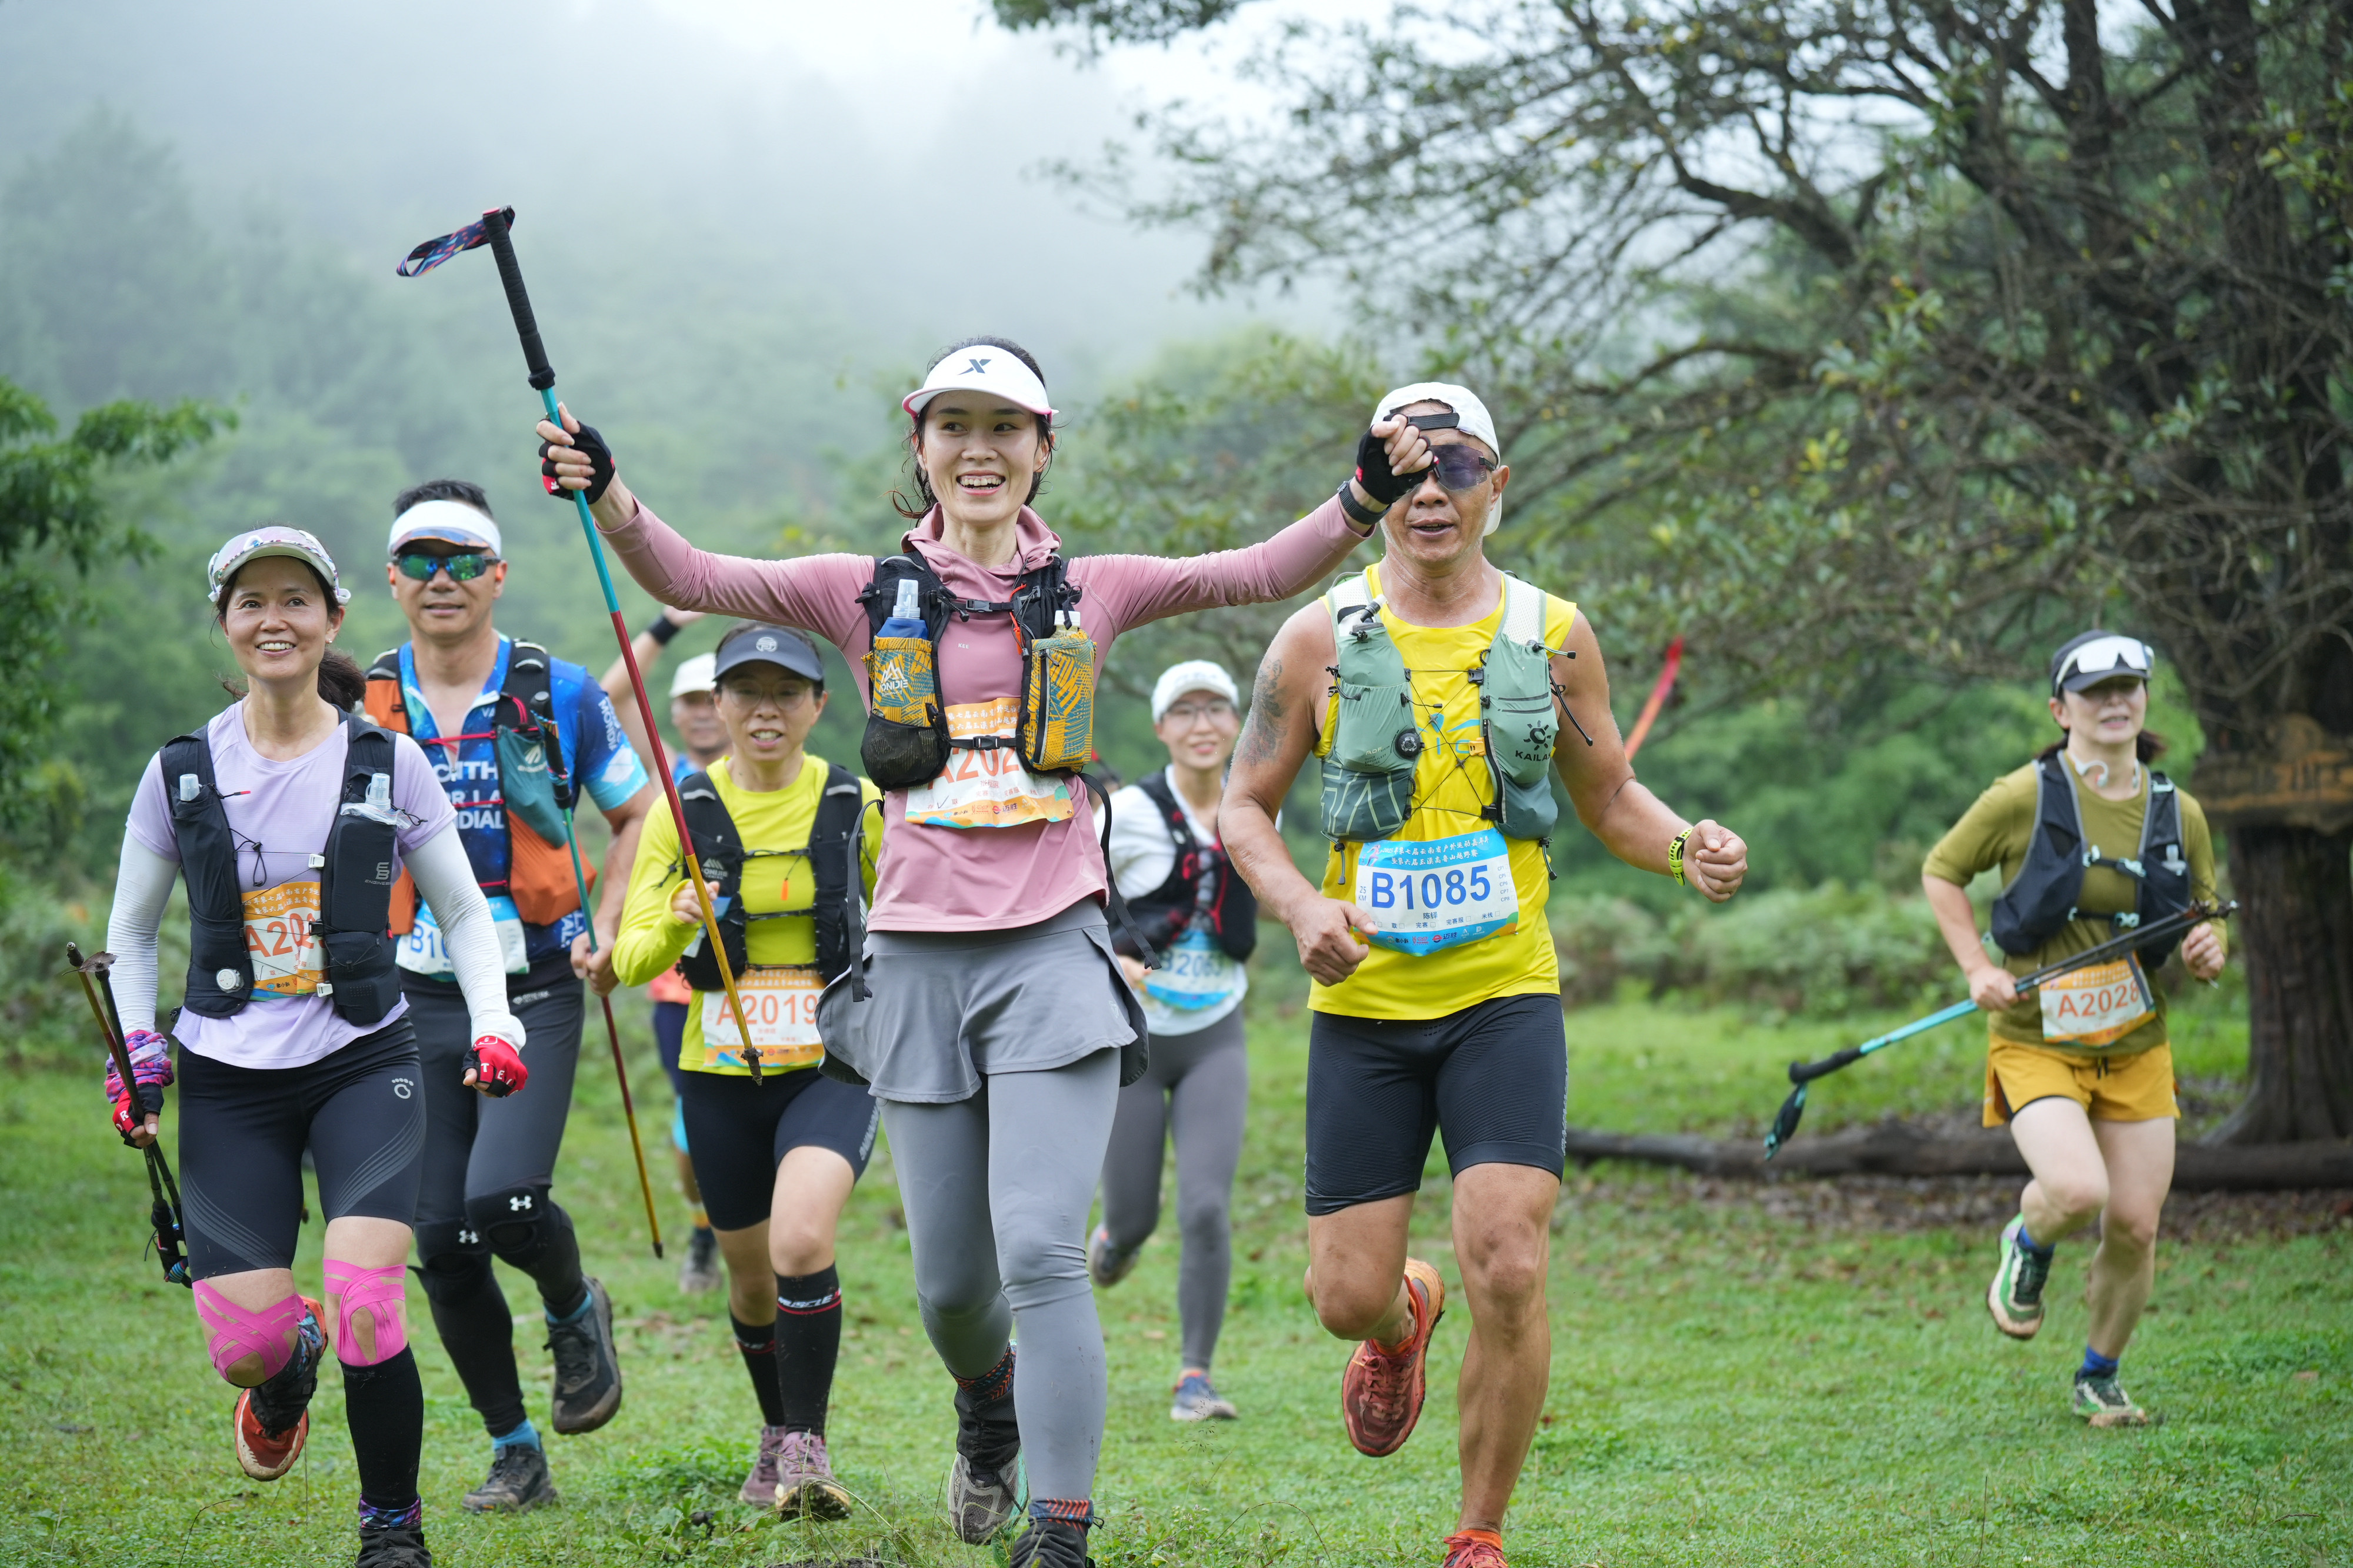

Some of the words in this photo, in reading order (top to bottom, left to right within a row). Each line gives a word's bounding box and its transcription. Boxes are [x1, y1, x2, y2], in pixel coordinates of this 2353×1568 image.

[1359, 886, 1366, 894] 25
[1372, 865, 1490, 910] B1085
[1447, 917, 1464, 925] 完赛服
[716, 994, 818, 1026] A2019
[2058, 979, 2140, 1017] A2028
